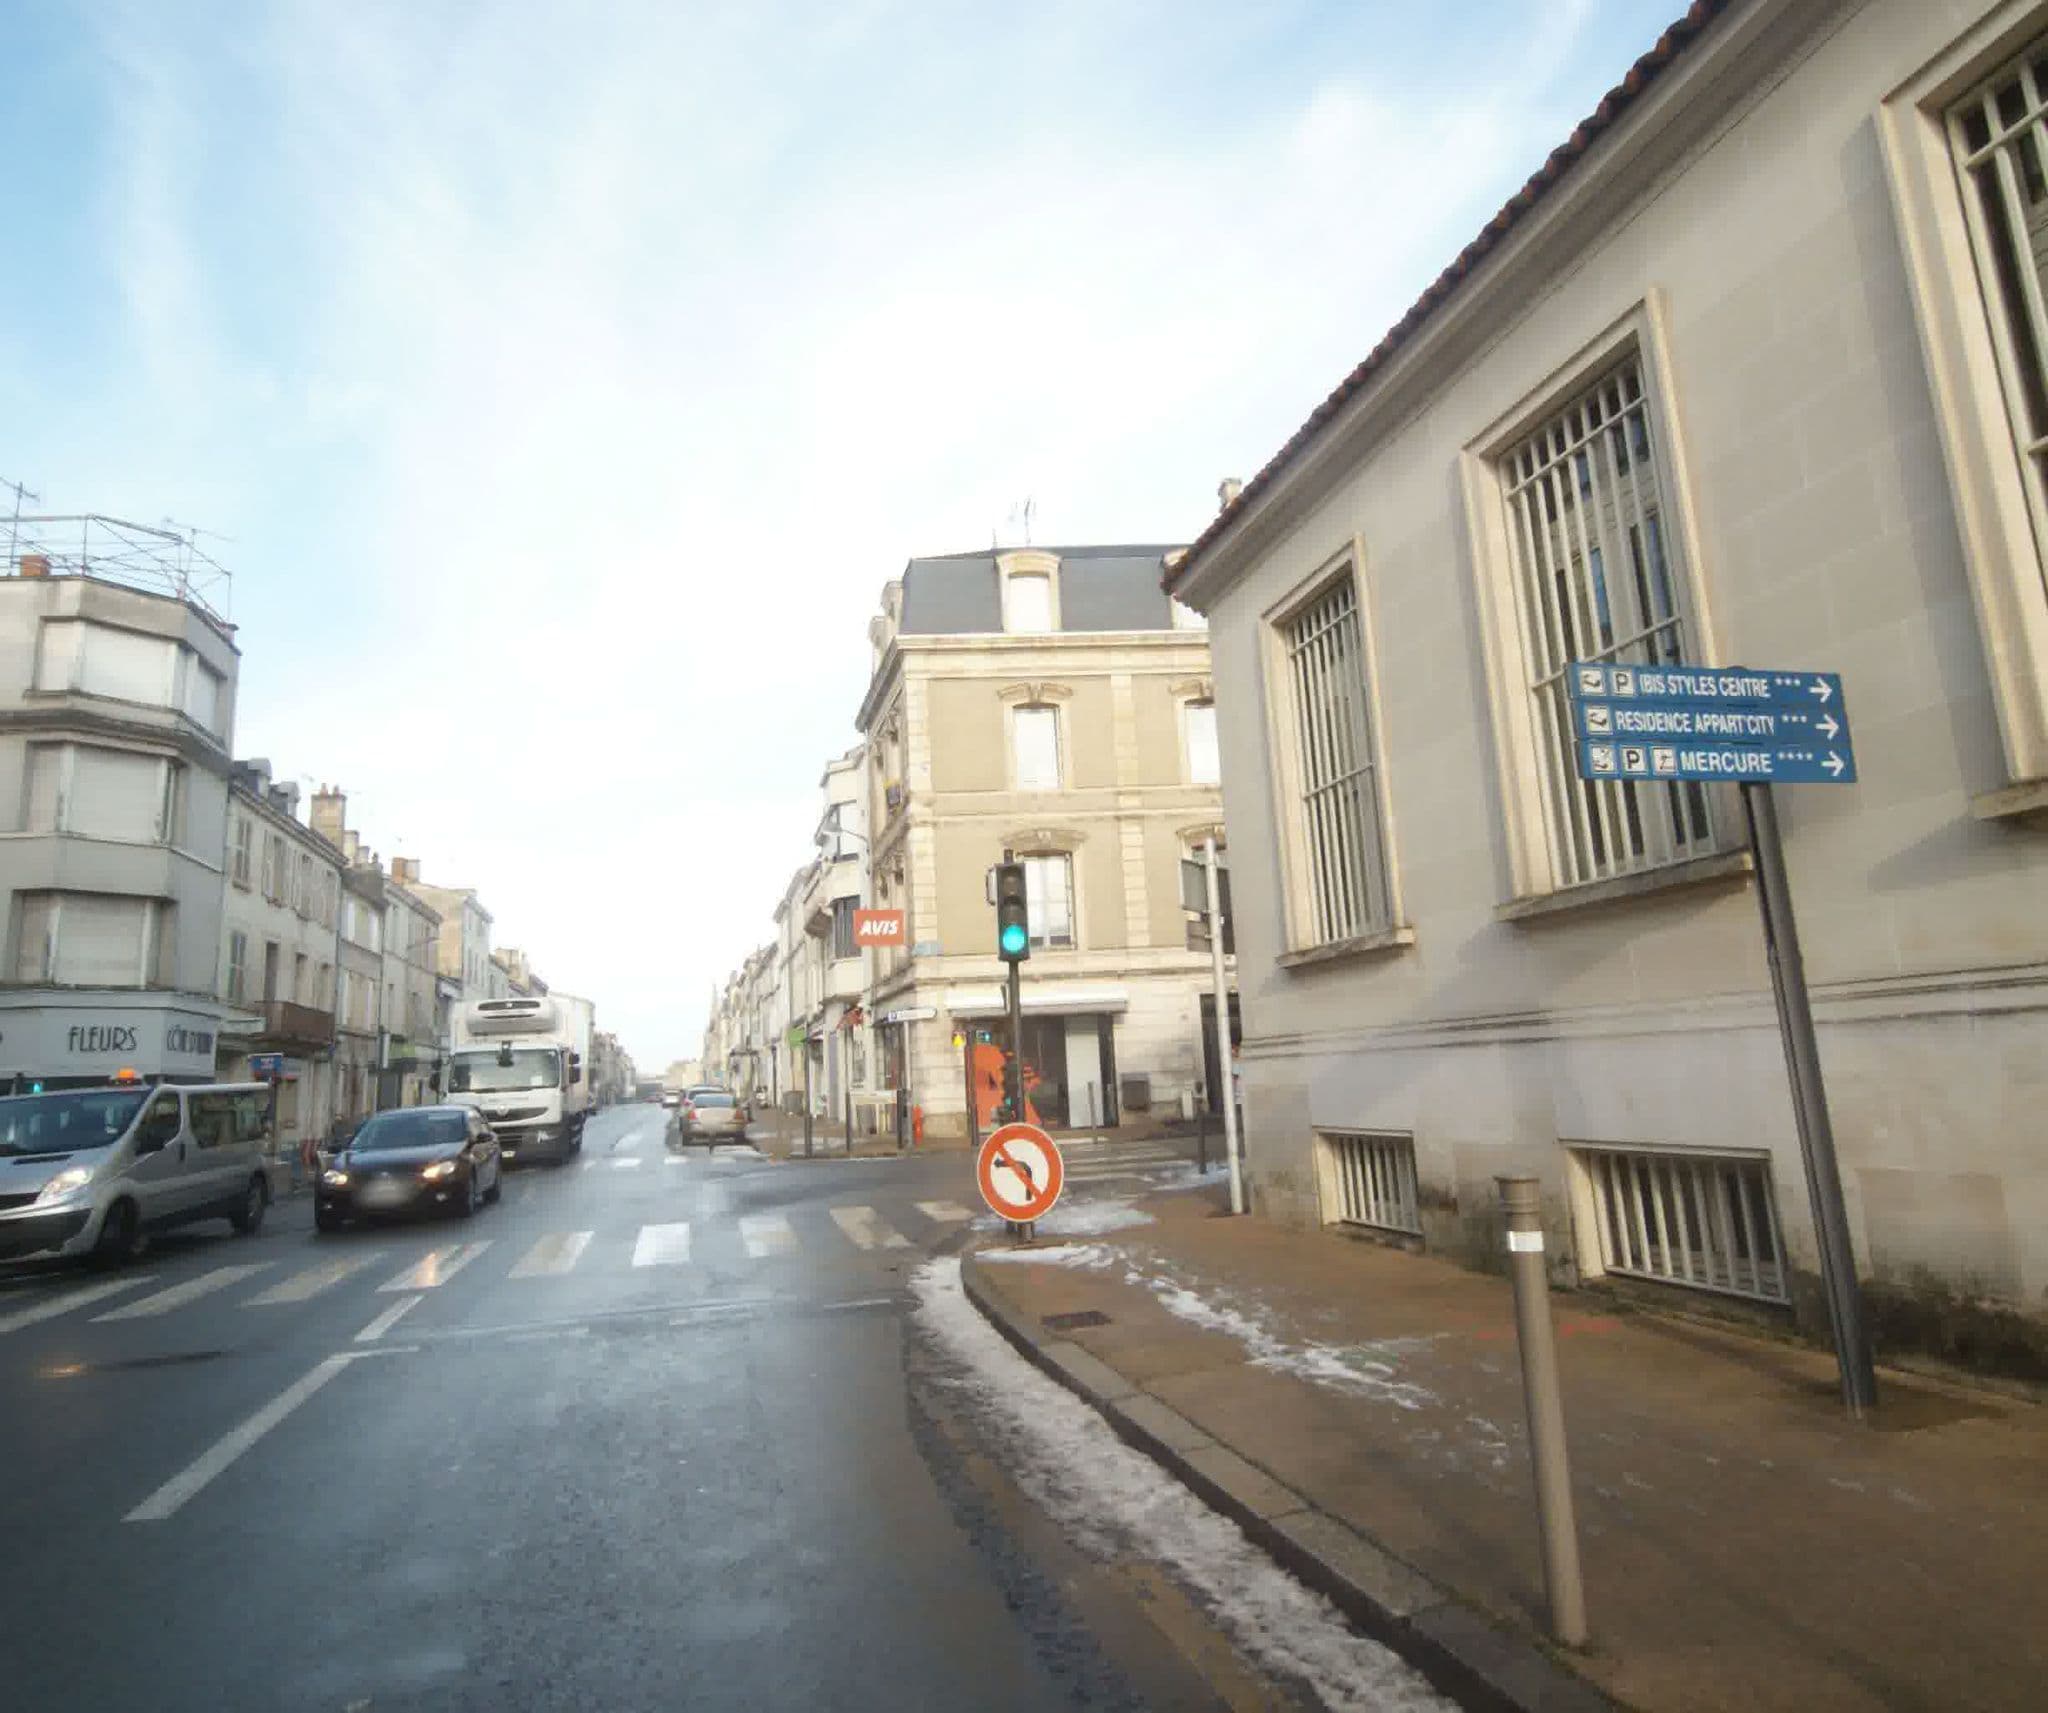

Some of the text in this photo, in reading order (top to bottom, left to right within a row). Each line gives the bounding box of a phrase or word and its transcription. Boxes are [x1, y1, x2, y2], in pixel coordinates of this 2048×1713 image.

[1639, 674, 1665, 694] IBIS
[1667, 674, 1717, 697] STYLES
[1718, 676, 1771, 698] CENTRE
[1615, 710, 1692, 733] RESIDENCE
[1680, 751, 1773, 773] MERCURE
[858, 919, 899, 937] AVIS
[67, 1026, 138, 1052] FLEURS
